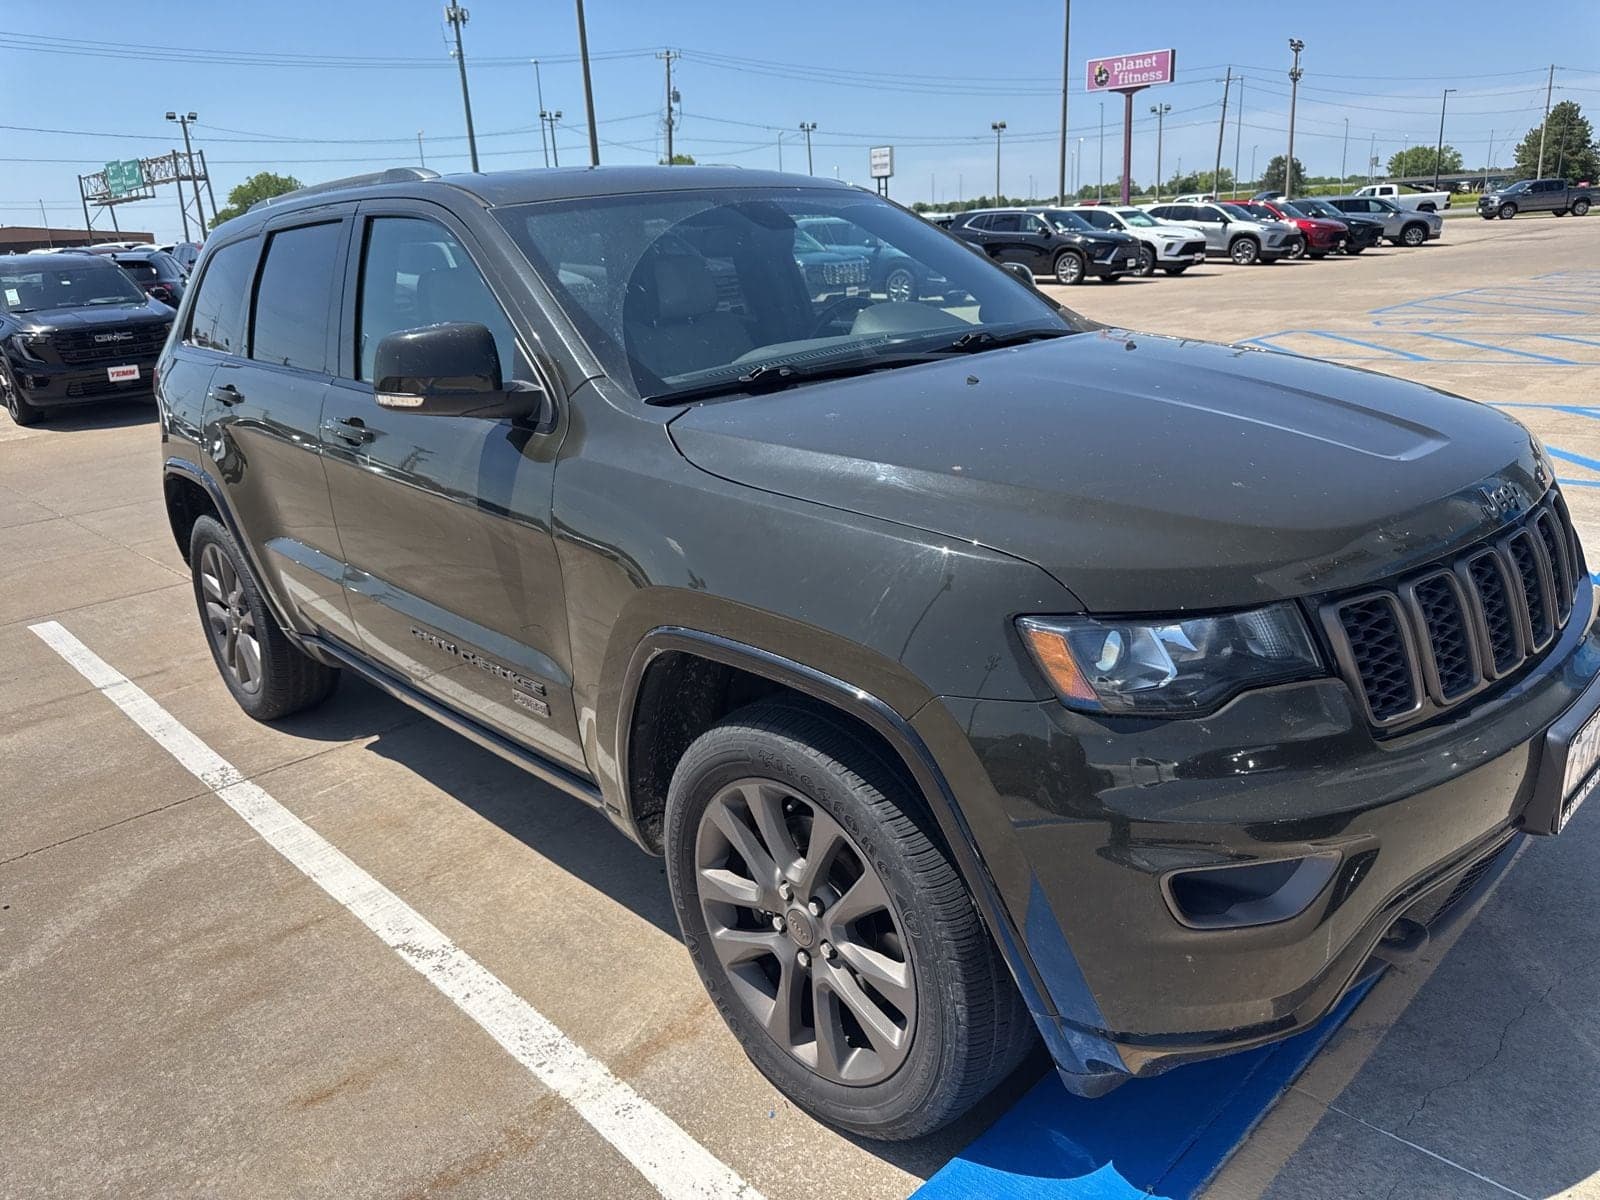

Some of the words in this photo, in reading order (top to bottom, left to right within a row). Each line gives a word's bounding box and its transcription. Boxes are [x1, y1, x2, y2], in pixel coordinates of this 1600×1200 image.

[1114, 56, 1156, 74] planet
[1118, 72, 1162, 85] fitness
[95, 331, 133, 342] GMC
[111, 368, 136, 378] YEMM
[460, 648, 547, 697] CHEROKEE
